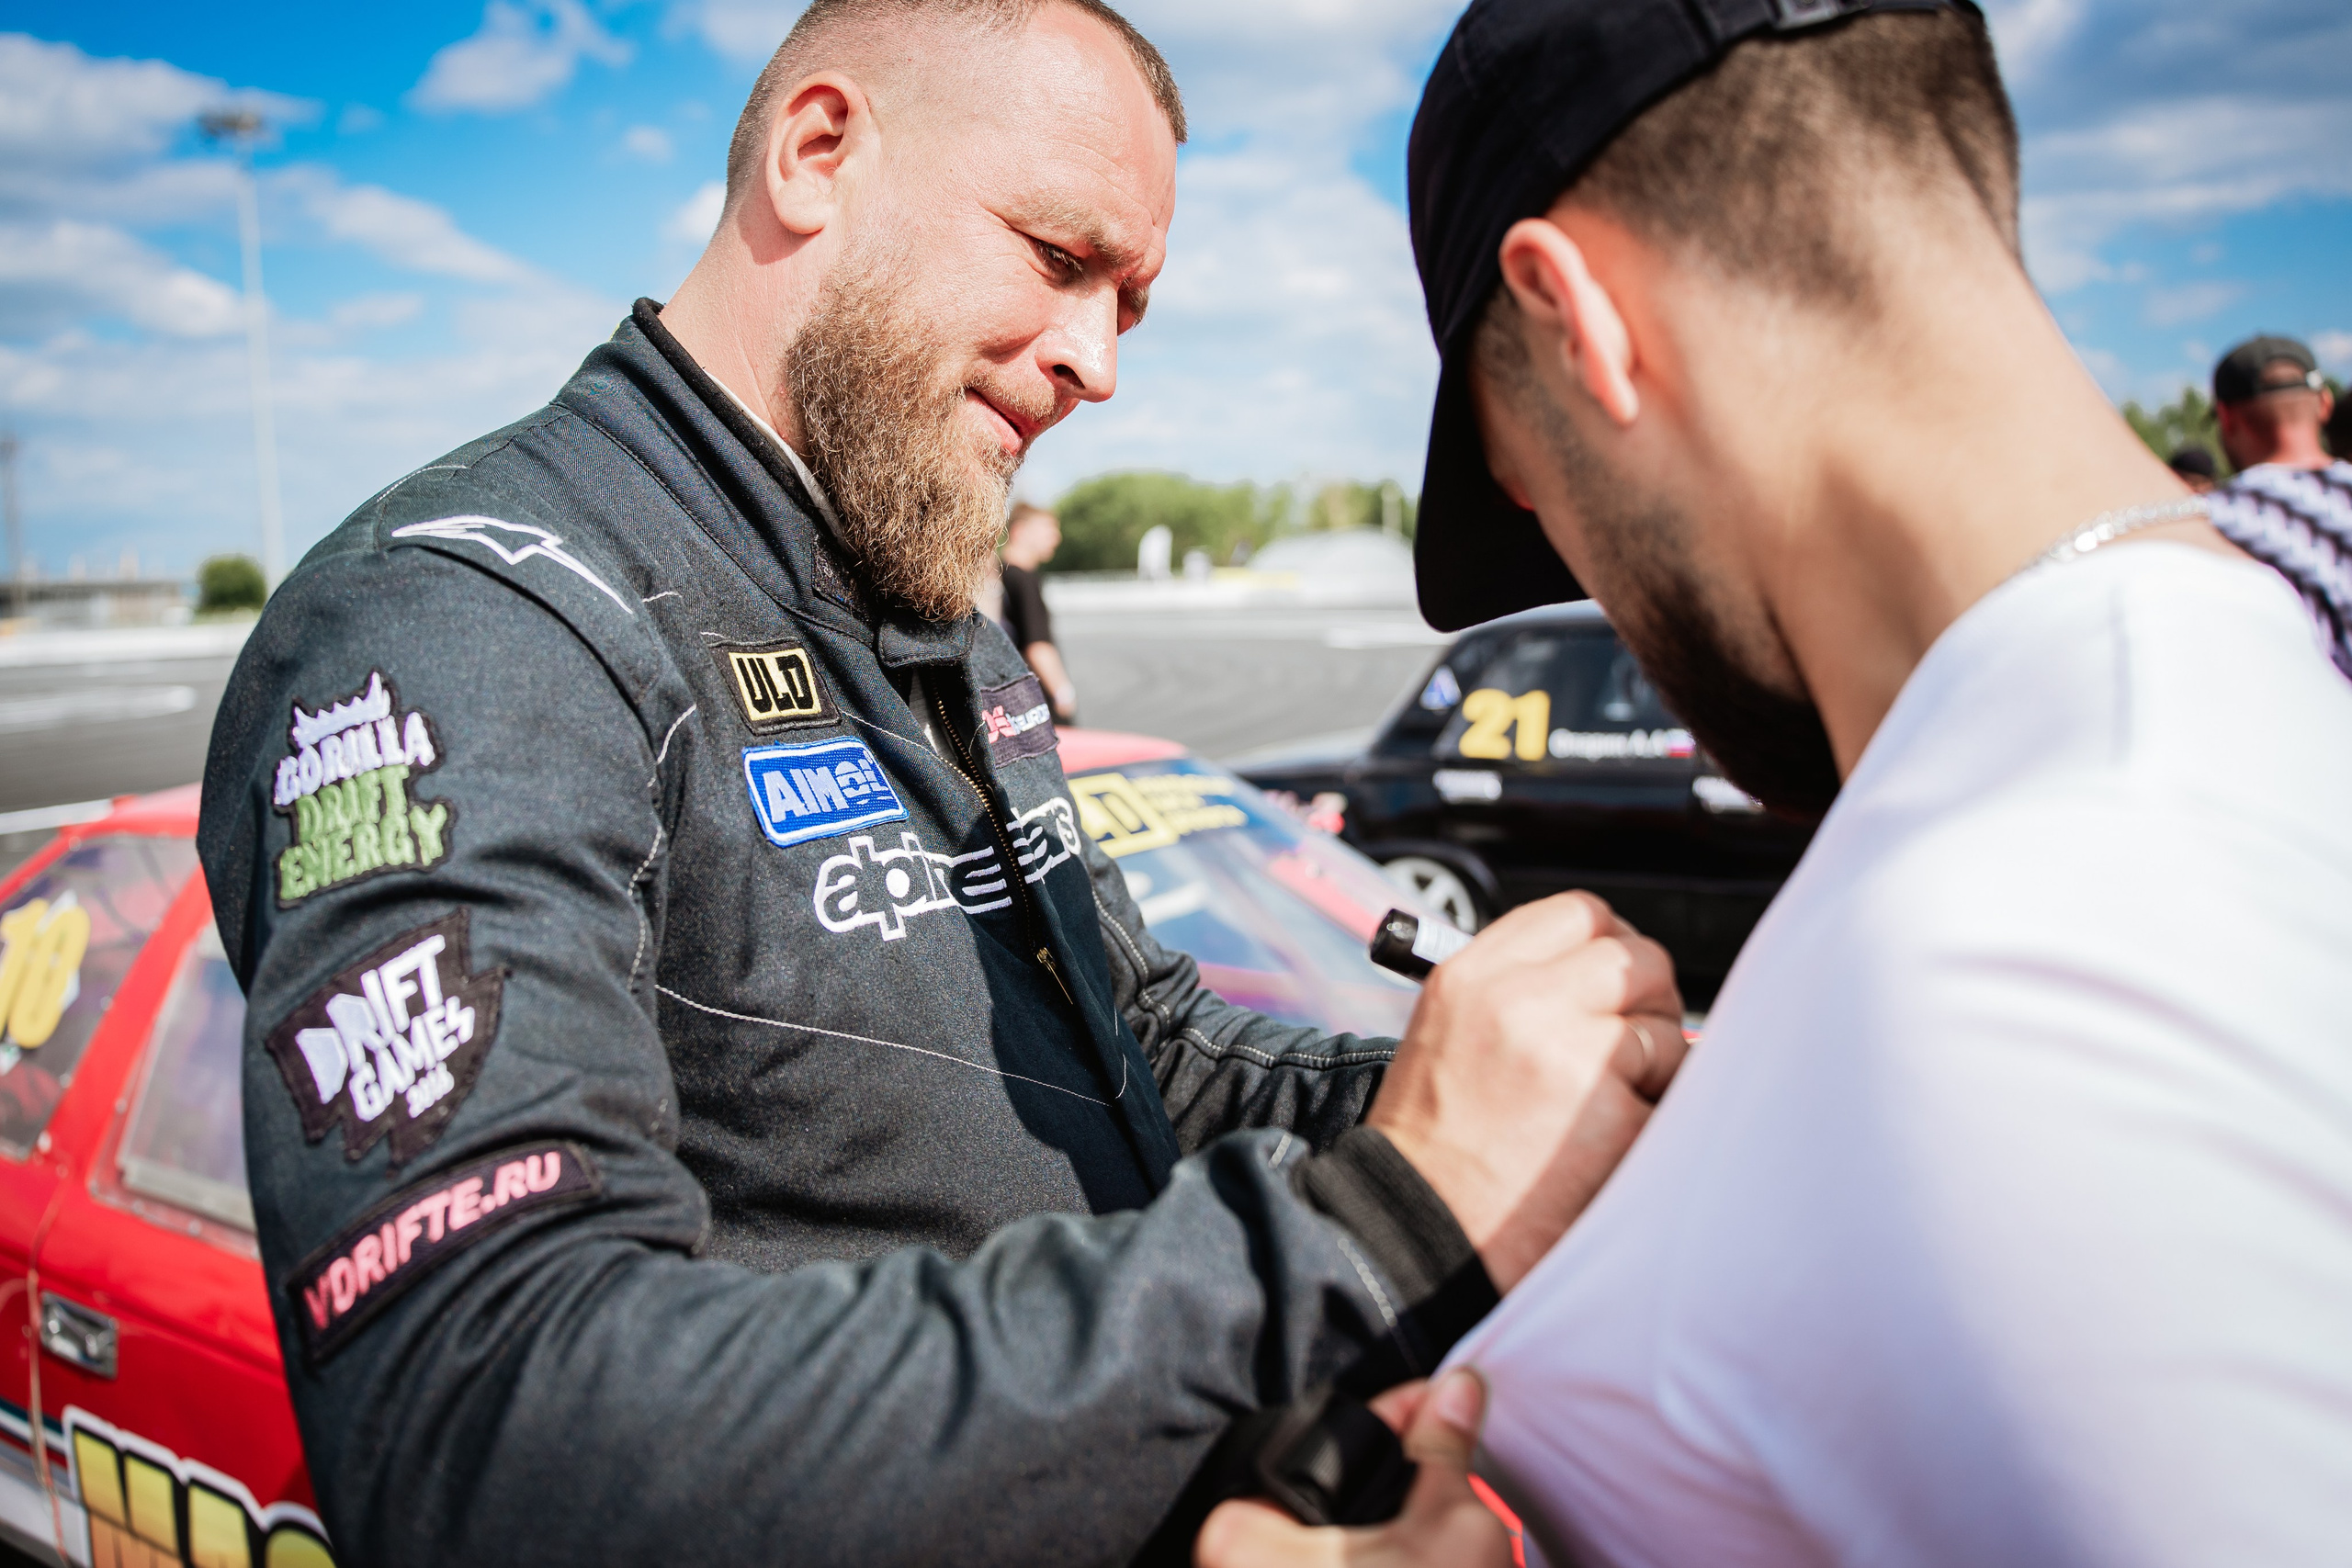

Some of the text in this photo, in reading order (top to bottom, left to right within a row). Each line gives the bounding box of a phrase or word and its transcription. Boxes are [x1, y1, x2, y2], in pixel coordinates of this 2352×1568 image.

[736, 654, 816, 714] ULD
[1459, 688, 1551, 761] 21
[276, 712, 435, 806] GORILLA
[296, 764, 410, 844] DRIFT
[762, 758, 889, 823] AIMOL
[279, 804, 447, 900] ENERGY
[295, 934, 446, 1104] DRIFT
[348, 995, 475, 1122] GAMES
[303, 1151, 562, 1331] VDRIFTE.RU
